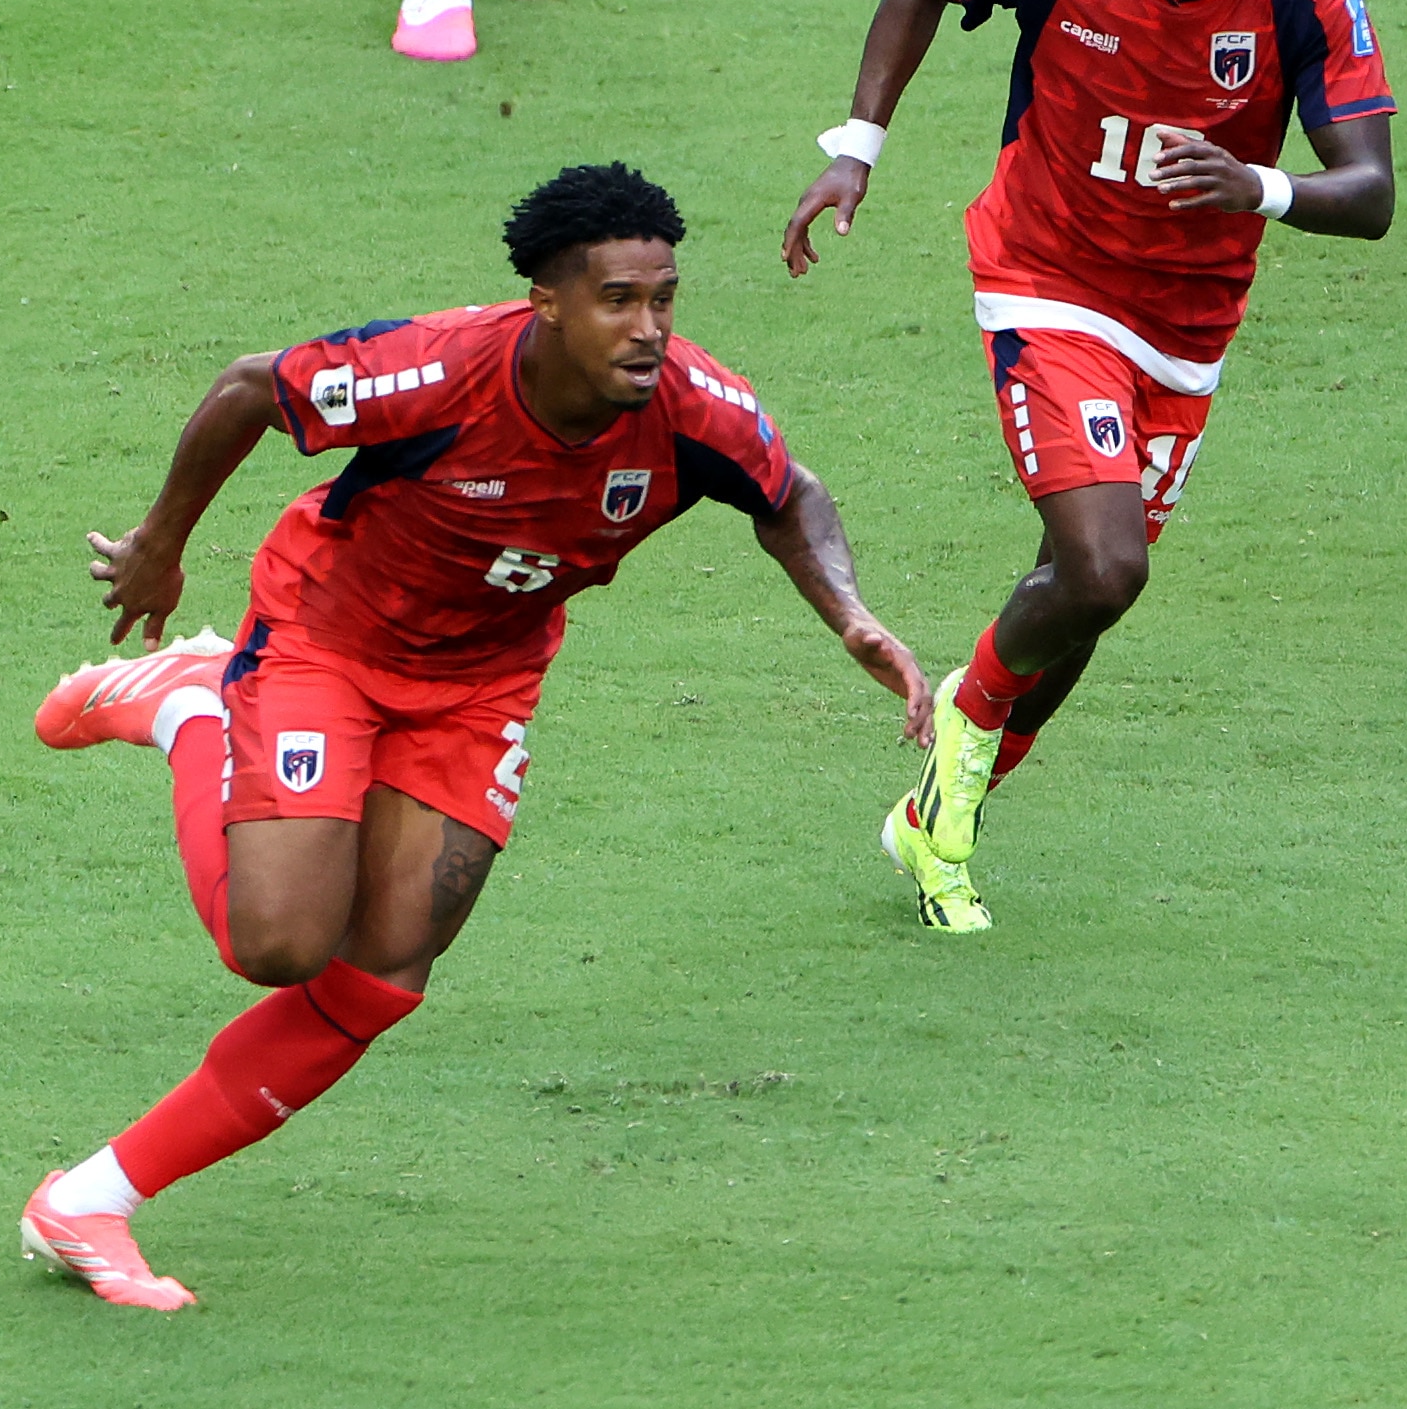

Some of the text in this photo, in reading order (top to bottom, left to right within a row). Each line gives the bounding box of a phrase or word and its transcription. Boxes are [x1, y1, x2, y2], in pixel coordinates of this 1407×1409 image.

[1060, 20, 1120, 52] capelli
[1214, 34, 1253, 45] FCF
[1083, 402, 1114, 412] FCF
